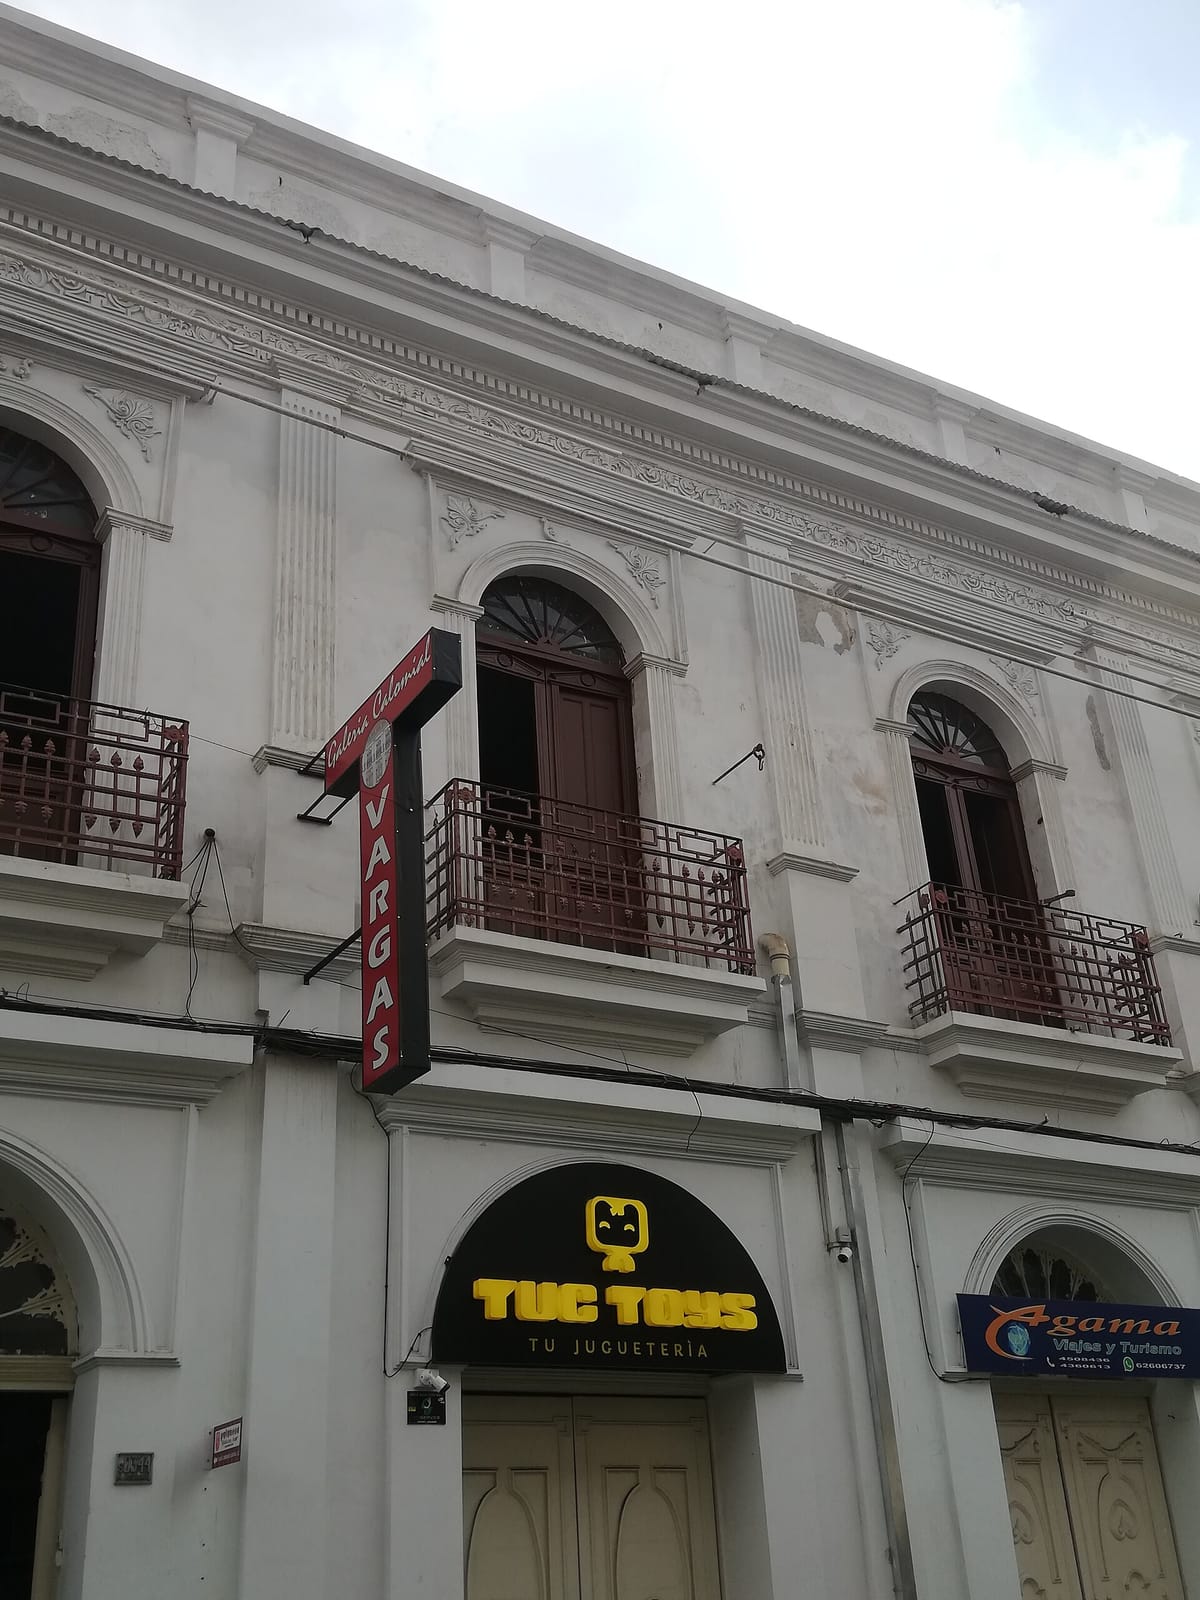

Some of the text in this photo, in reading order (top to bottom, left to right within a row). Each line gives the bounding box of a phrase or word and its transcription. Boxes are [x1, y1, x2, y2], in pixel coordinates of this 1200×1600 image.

[365, 784, 394, 1070] VARGAS
[473, 1278, 758, 1331] TUC TOYS
[985, 1304, 1182, 1358] Agama
[528, 1337, 555, 1352] TU
[1052, 1338, 1183, 1356] Viajes y Turismo
